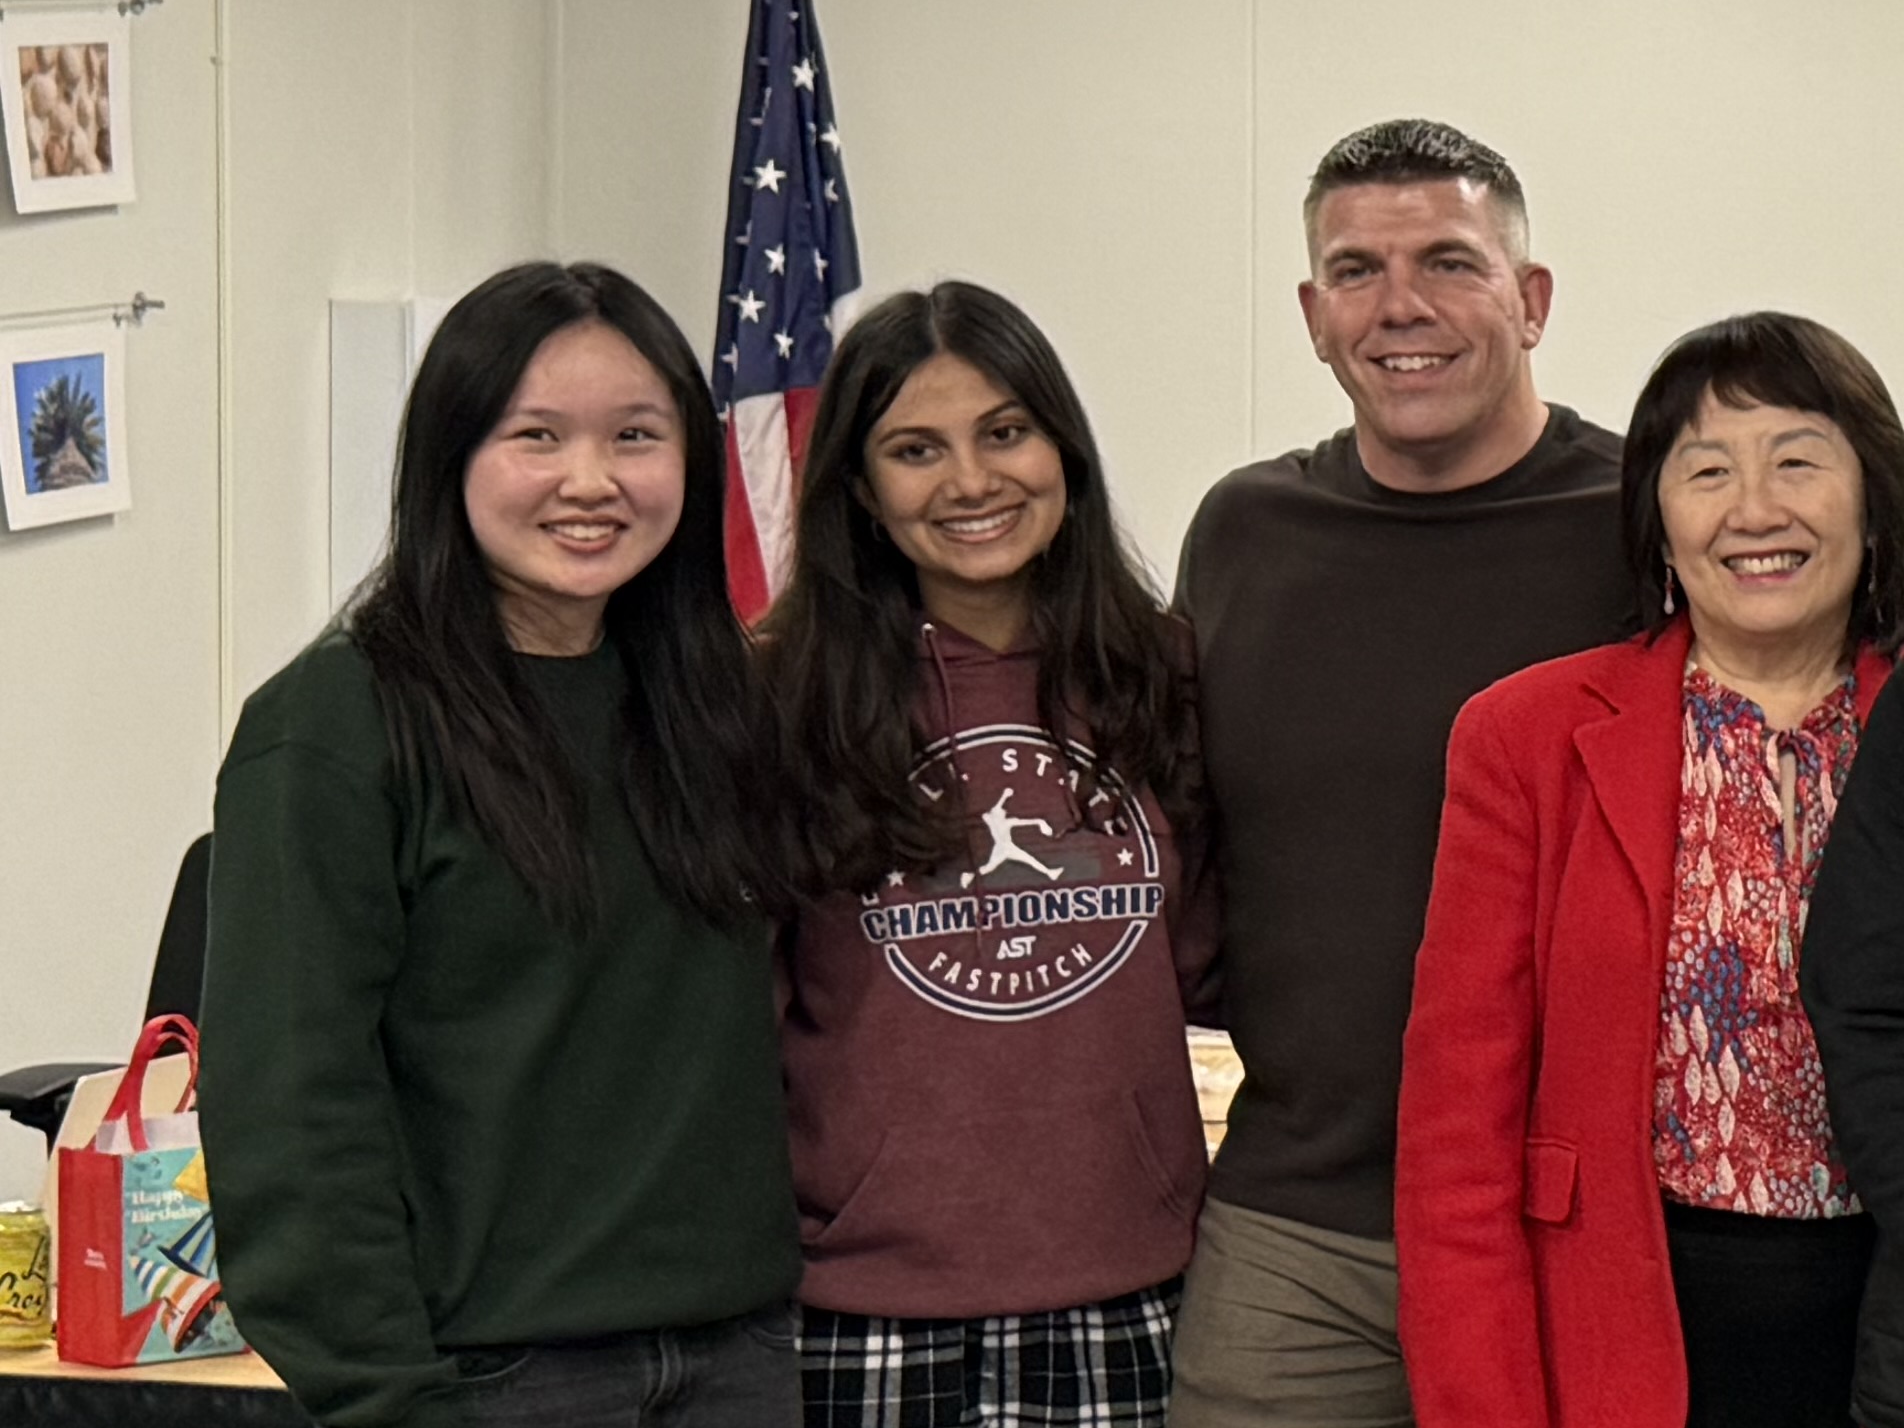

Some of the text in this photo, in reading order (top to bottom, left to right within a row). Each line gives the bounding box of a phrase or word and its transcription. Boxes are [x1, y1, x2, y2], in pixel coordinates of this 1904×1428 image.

[860, 884, 1165, 943] CHAMPIONSHIP
[929, 942, 1094, 996] FASTPITCH
[131, 1189, 184, 1209] Happy
[131, 1206, 205, 1224] Birthday
